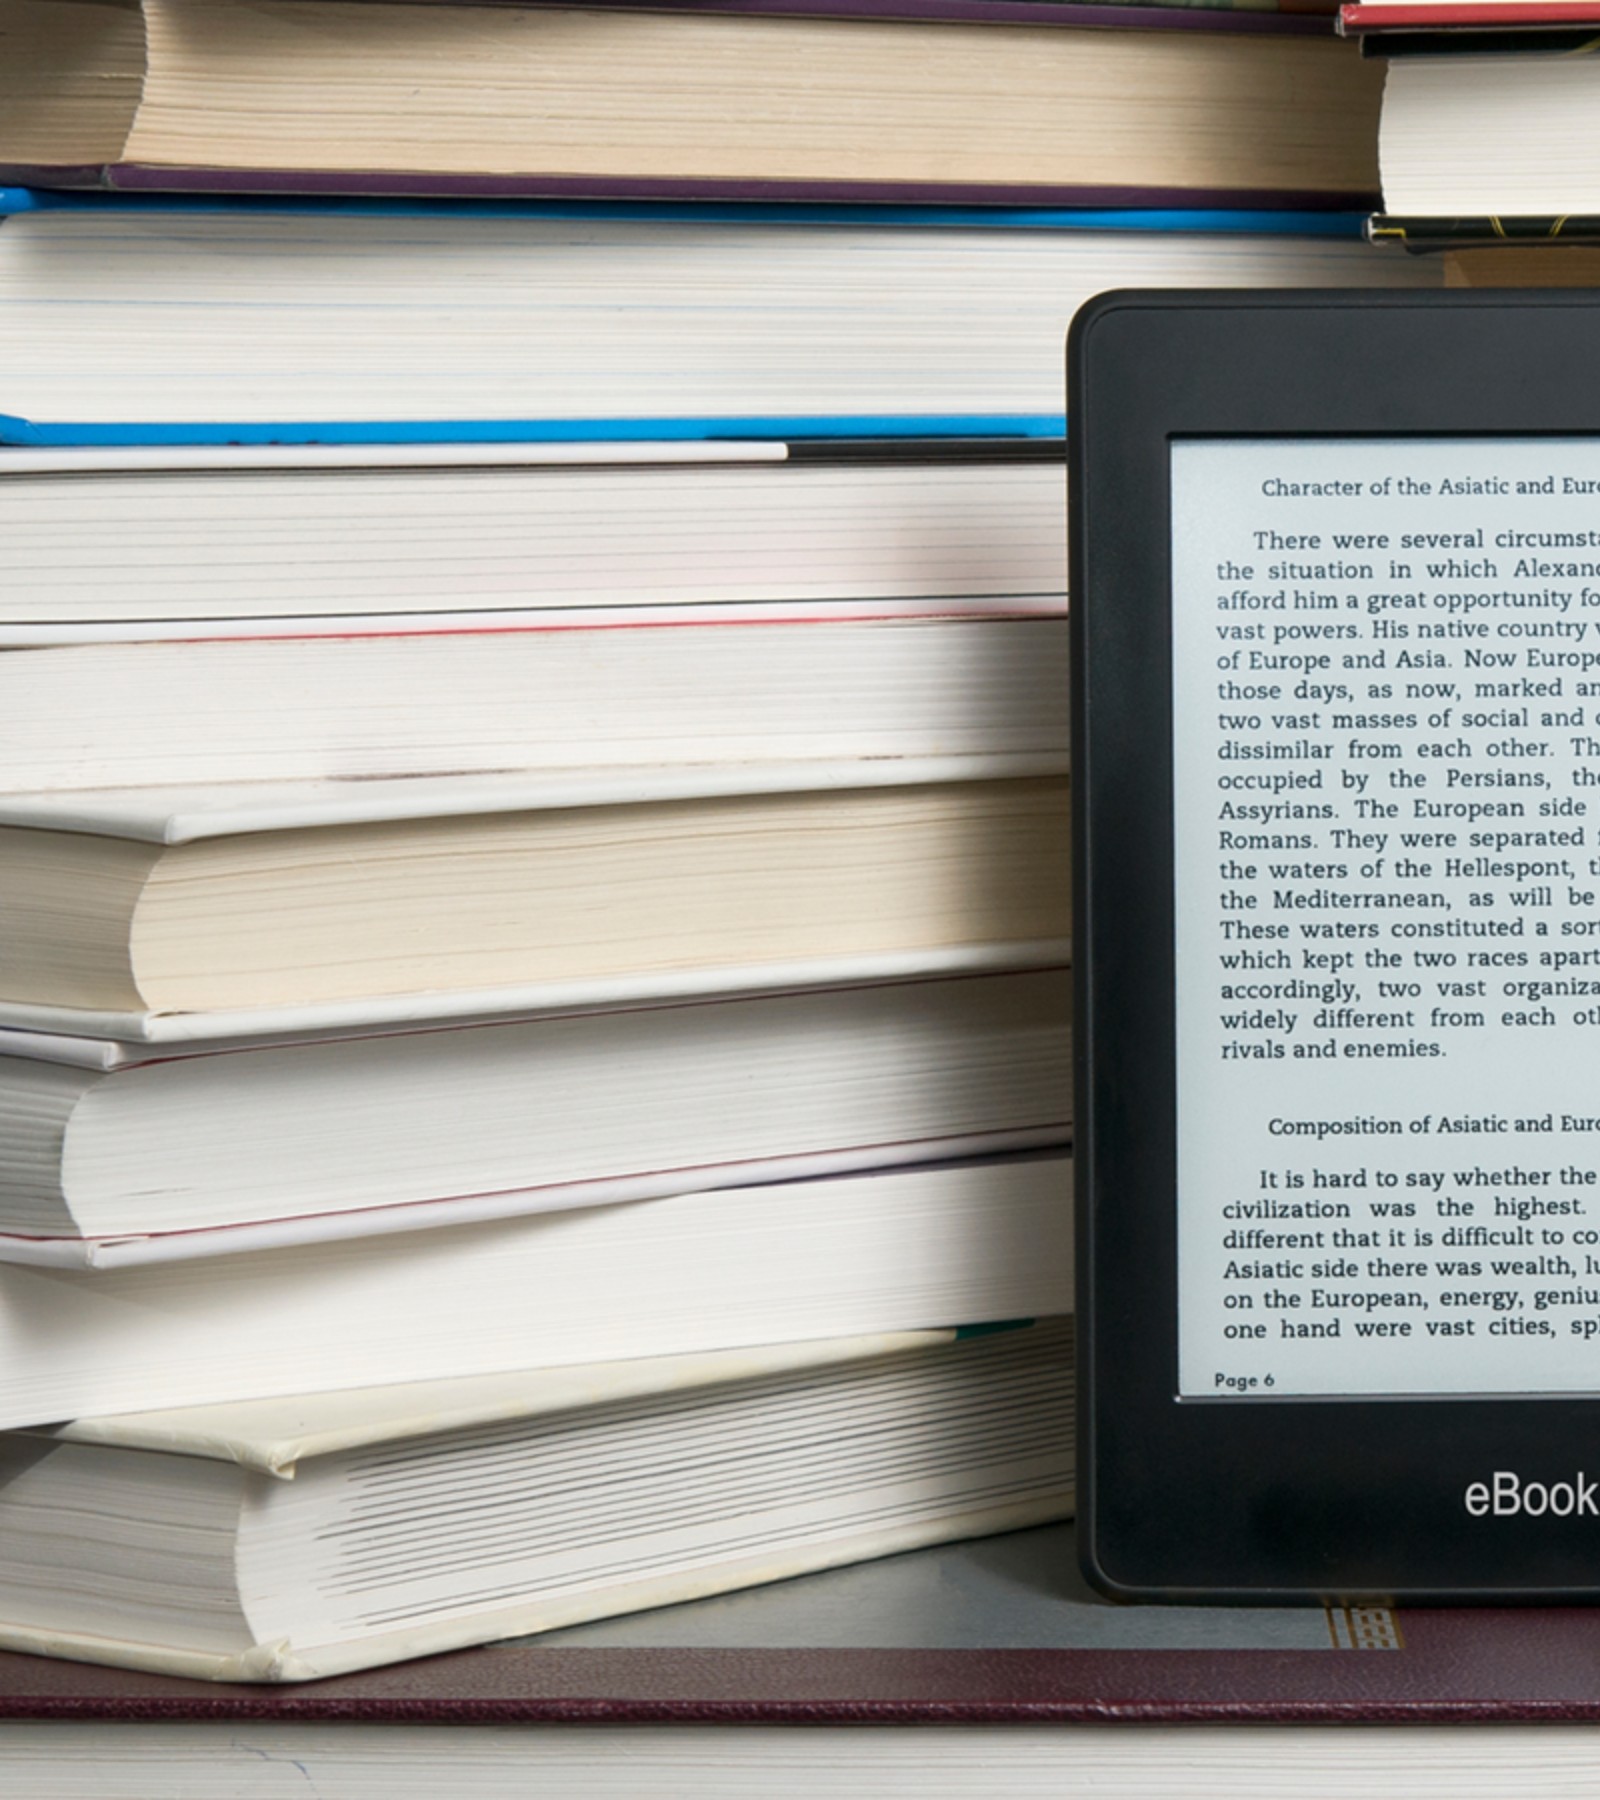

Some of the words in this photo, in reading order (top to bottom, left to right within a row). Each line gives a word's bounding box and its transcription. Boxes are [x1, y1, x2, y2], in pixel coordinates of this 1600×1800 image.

[1261, 478, 1364, 496] Character
[1369, 477, 1392, 495] of
[1397, 477, 1432, 495] the
[1438, 477, 1510, 494] Asiatic
[1516, 476, 1555, 494] and
[1253, 531, 1322, 549] There
[1331, 535, 1390, 549] were
[1400, 529, 1484, 548] several
[1217, 590, 1287, 610] afford
[1293, 590, 1339, 609] him
[1346, 595, 1359, 608] a
[1367, 592, 1427, 614] great
[1433, 589, 1573, 613] opportunity
[1216, 651, 1242, 670] of
[1249, 651, 1331, 674] Europe
[1342, 649, 1386, 668] and
[1395, 650, 1453, 668] Asia.
[1464, 649, 1517, 667] Now
[1217, 681, 1282, 699] those
[1293, 680, 1354, 704] days,
[1367, 685, 1393, 698] as
[1405, 684, 1462, 701] now,
[1474, 678, 1563, 697] marked
[1217, 740, 1335, 760] dissimilar
[1348, 739, 1403, 758] from
[1417, 738, 1472, 758] each
[1485, 738, 1555, 756] other.
[1218, 801, 1339, 824] Assyrians.
[1353, 799, 1399, 818] The
[1413, 799, 1525, 822] European
[1538, 797, 1587, 816] side
[1219, 860, 1258, 879] the
[1268, 863, 1349, 878] waters
[1359, 858, 1385, 878] of
[1394, 858, 1433, 878] the
[1445, 858, 1576, 882] Hellespont,
[1219, 920, 1290, 939] These
[1299, 922, 1380, 938] waters
[1390, 917, 1524, 937] constituted
[1535, 922, 1549, 936] a
[1219, 949, 1292, 969] which
[1302, 949, 1354, 974] kept
[1364, 948, 1403, 968] the
[1413, 951, 1457, 967] two
[1467, 952, 1529, 966] races
[1219, 1009, 1298, 1034] widely
[1313, 1008, 1415, 1028] different
[1430, 1008, 1485, 1027] from
[1501, 1006, 1556, 1026] each
[1221, 1039, 1286, 1059] rivals
[1292, 1038, 1337, 1058] and
[1343, 1039, 1447, 1058] enemies.
[1268, 1116, 1403, 1140] Composition
[1408, 1115, 1432, 1134] of
[1436, 1114, 1509, 1133] Asiatic
[1514, 1114, 1554, 1132] and
[1260, 1170, 1279, 1189] It
[1285, 1170, 1305, 1188] is
[1312, 1168, 1368, 1188] hard
[1375, 1171, 1399, 1187] to
[1405, 1173, 1446, 1192] say
[1452, 1166, 1552, 1186] whether
[1559, 1166, 1598, 1185] the
[1222, 1230, 1325, 1249] different
[1332, 1228, 1381, 1248] that
[1388, 1229, 1407, 1247] it
[1414, 1228, 1434, 1246] is
[1441, 1226, 1534, 1246] difficult
[1541, 1229, 1565, 1245] to
[1222, 1260, 1304, 1279] Asiatic
[1311, 1258, 1359, 1278] side
[1366, 1258, 1429, 1277] there
[1435, 1262, 1483, 1276] was
[1490, 1256, 1577, 1278] wealth,
[1223, 1295, 1254, 1308] on
[1263, 1289, 1302, 1308] the
[1311, 1289, 1429, 1312] European,
[1439, 1292, 1525, 1311] energy,
[1223, 1325, 1267, 1338] one
[1280, 1318, 1341, 1338] hand
[1354, 1323, 1413, 1337] were
[1425, 1320, 1476, 1336] vast
[1488, 1317, 1557, 1338] cities,
[1214, 1372, 1258, 1392] Page
[1263, 1373, 1275, 1387] 6
[1464, 1471, 1600, 1516] eBook
